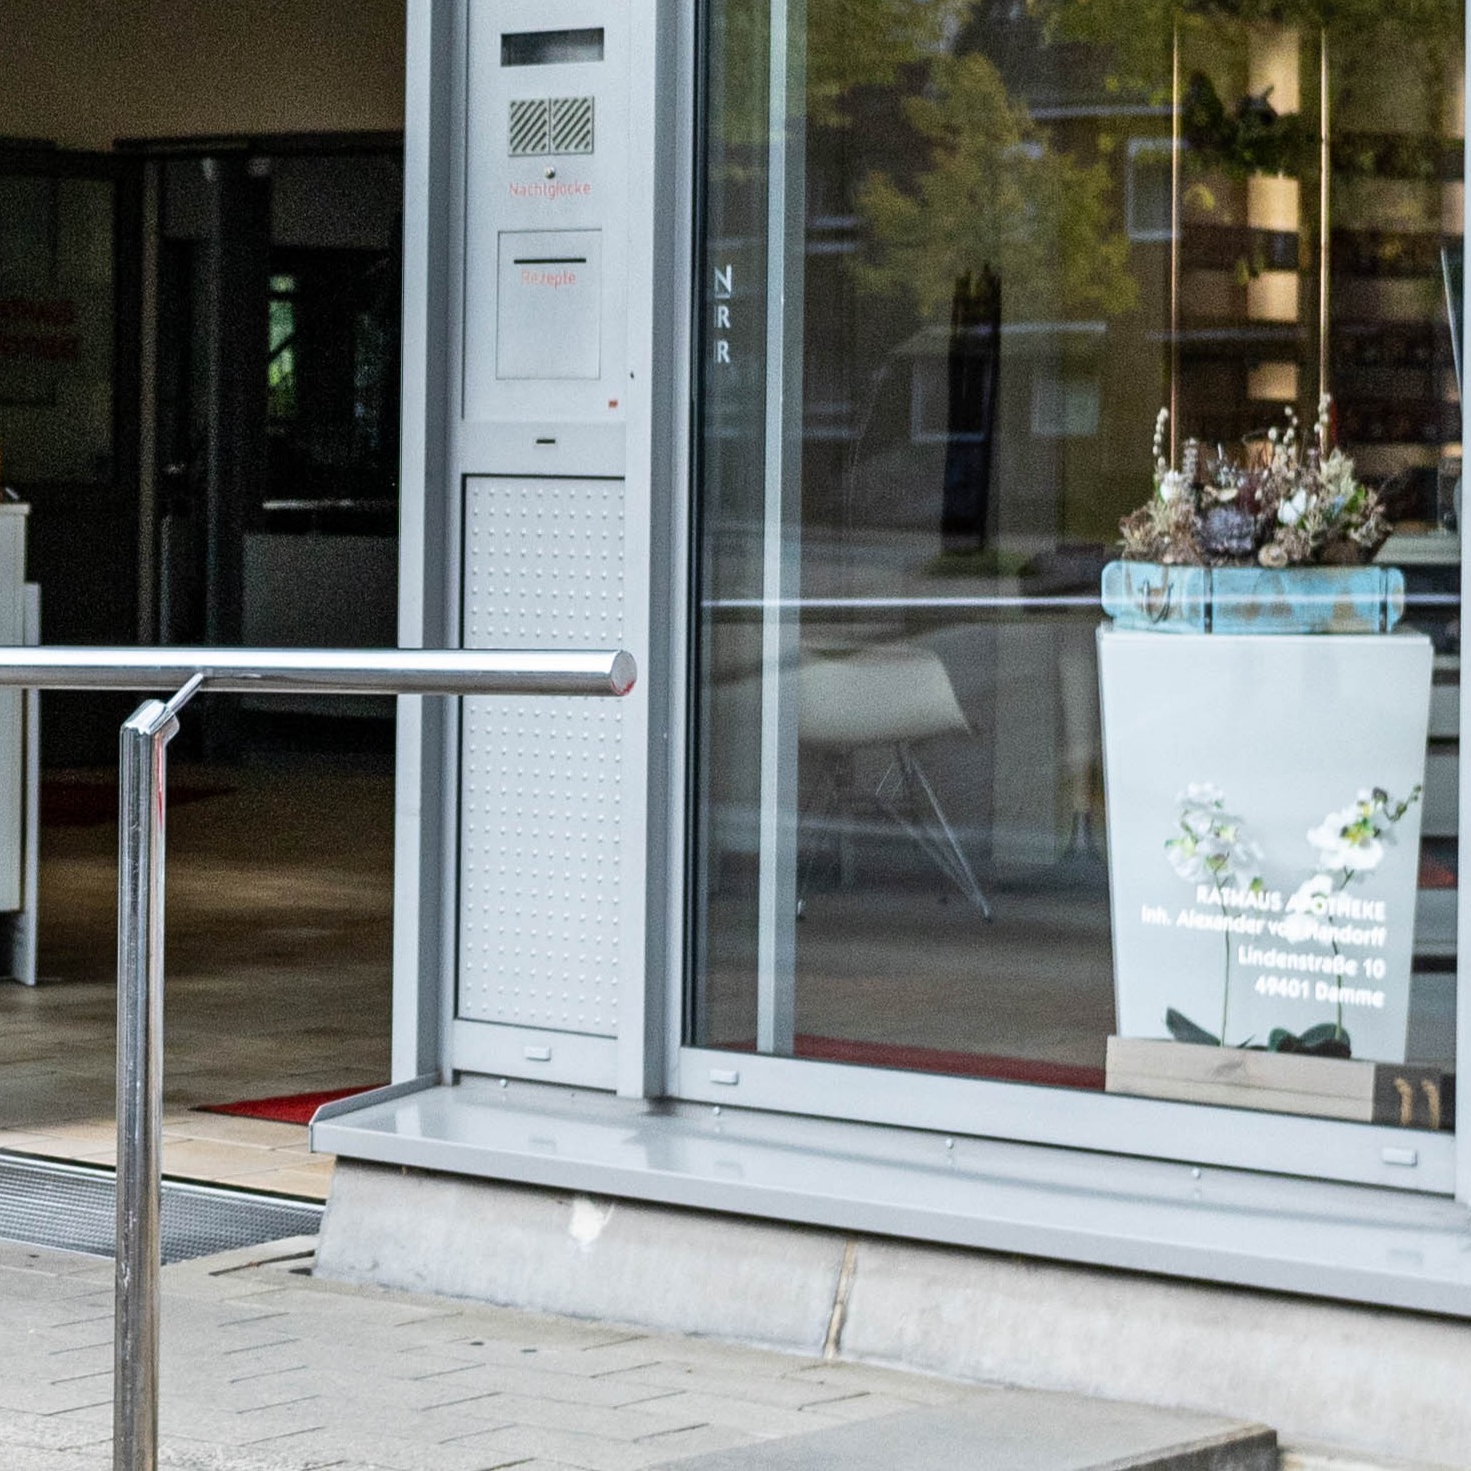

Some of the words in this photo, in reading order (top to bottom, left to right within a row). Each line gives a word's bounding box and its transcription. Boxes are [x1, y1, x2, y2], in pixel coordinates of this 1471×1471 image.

[508, 181, 592, 200] Nachtglocke
[521, 269, 578, 289] Rezepte
[1196, 884, 1282, 911] RATHAUS
[1141, 904, 1171, 926] Inh.
[1176, 909, 1266, 934] Alexander
[1238, 945, 1359, 976] Lindenstraße
[1363, 958, 1387, 980] 10
[1254, 975, 1310, 1000] 49401
[1315, 981, 1386, 1008] Damme
